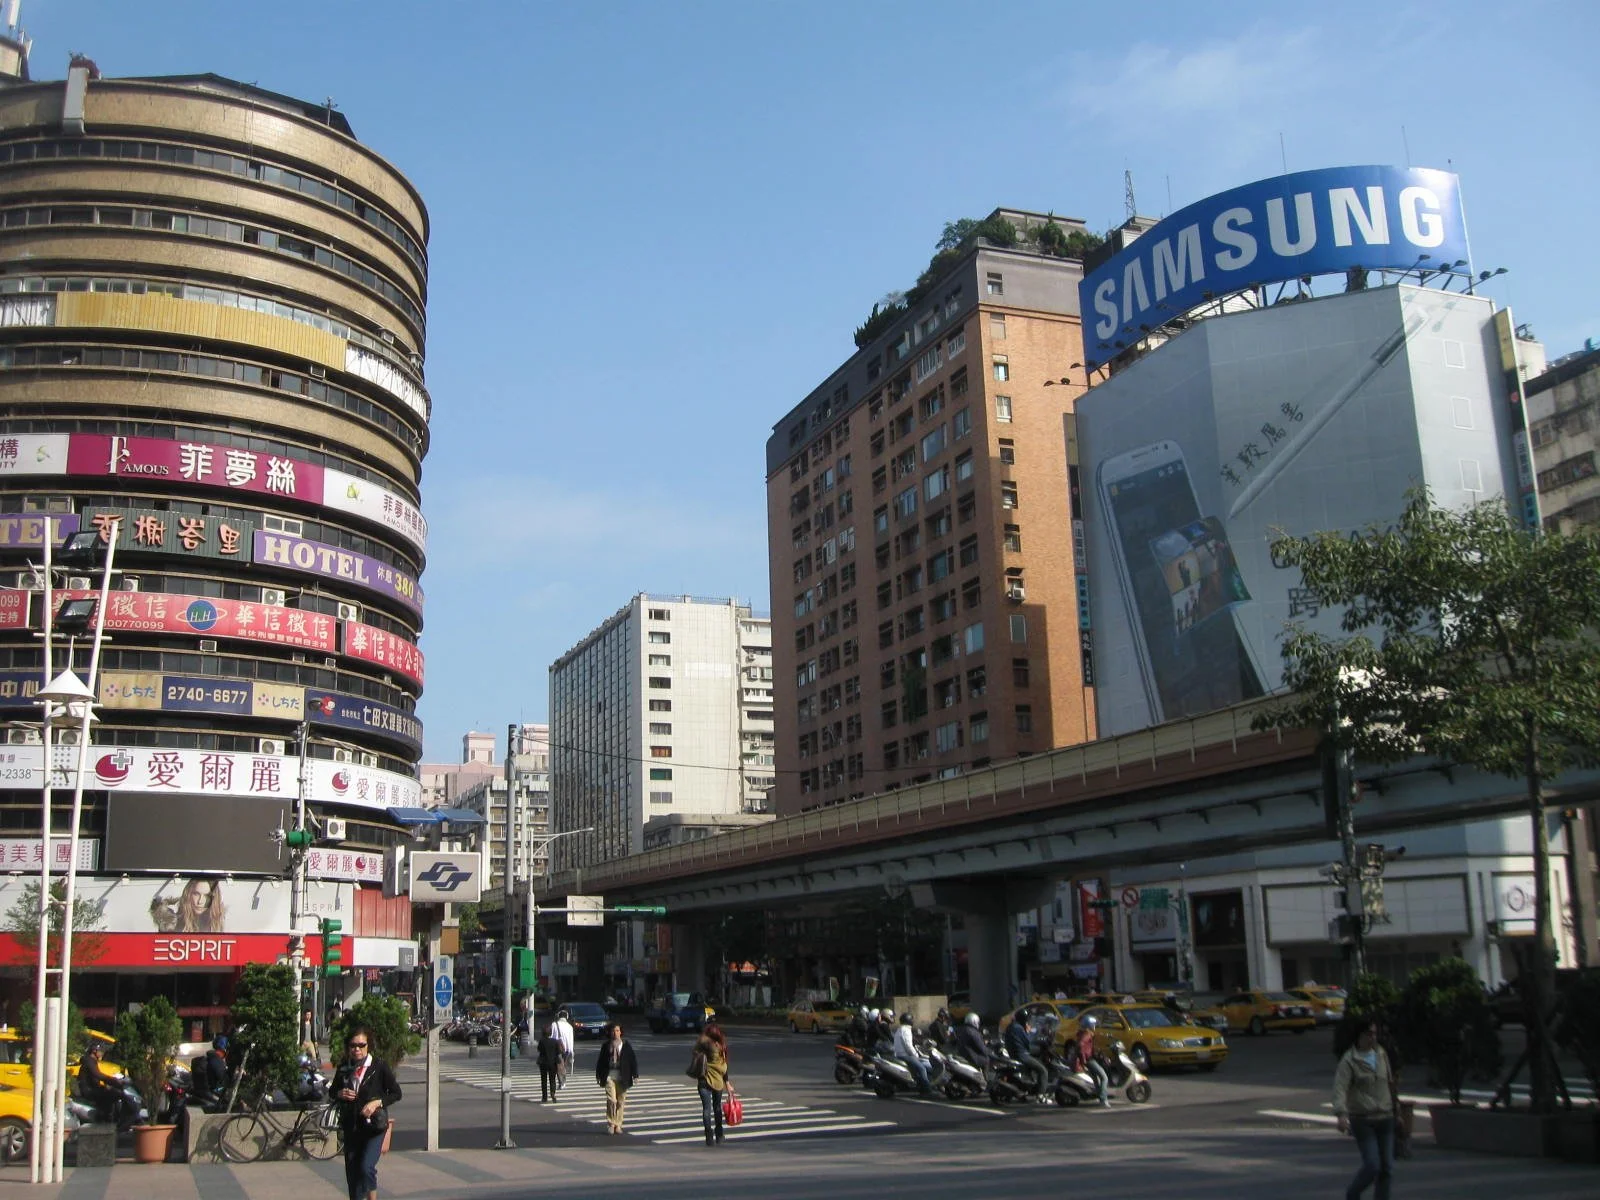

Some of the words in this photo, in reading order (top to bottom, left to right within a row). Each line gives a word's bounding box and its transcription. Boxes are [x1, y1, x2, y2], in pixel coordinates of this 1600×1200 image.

[1094, 186, 1444, 340] SAMSUNG
[179, 443, 297, 495] 菲夢絲
[263, 536, 370, 584] HOTEL
[394, 573, 414, 599] 380
[234, 604, 330, 640] 華信徵信
[167, 685, 248, 706] 2740-6677
[146, 750, 282, 793] 愛爾麗
[153, 939, 236, 963] ESPRIT
